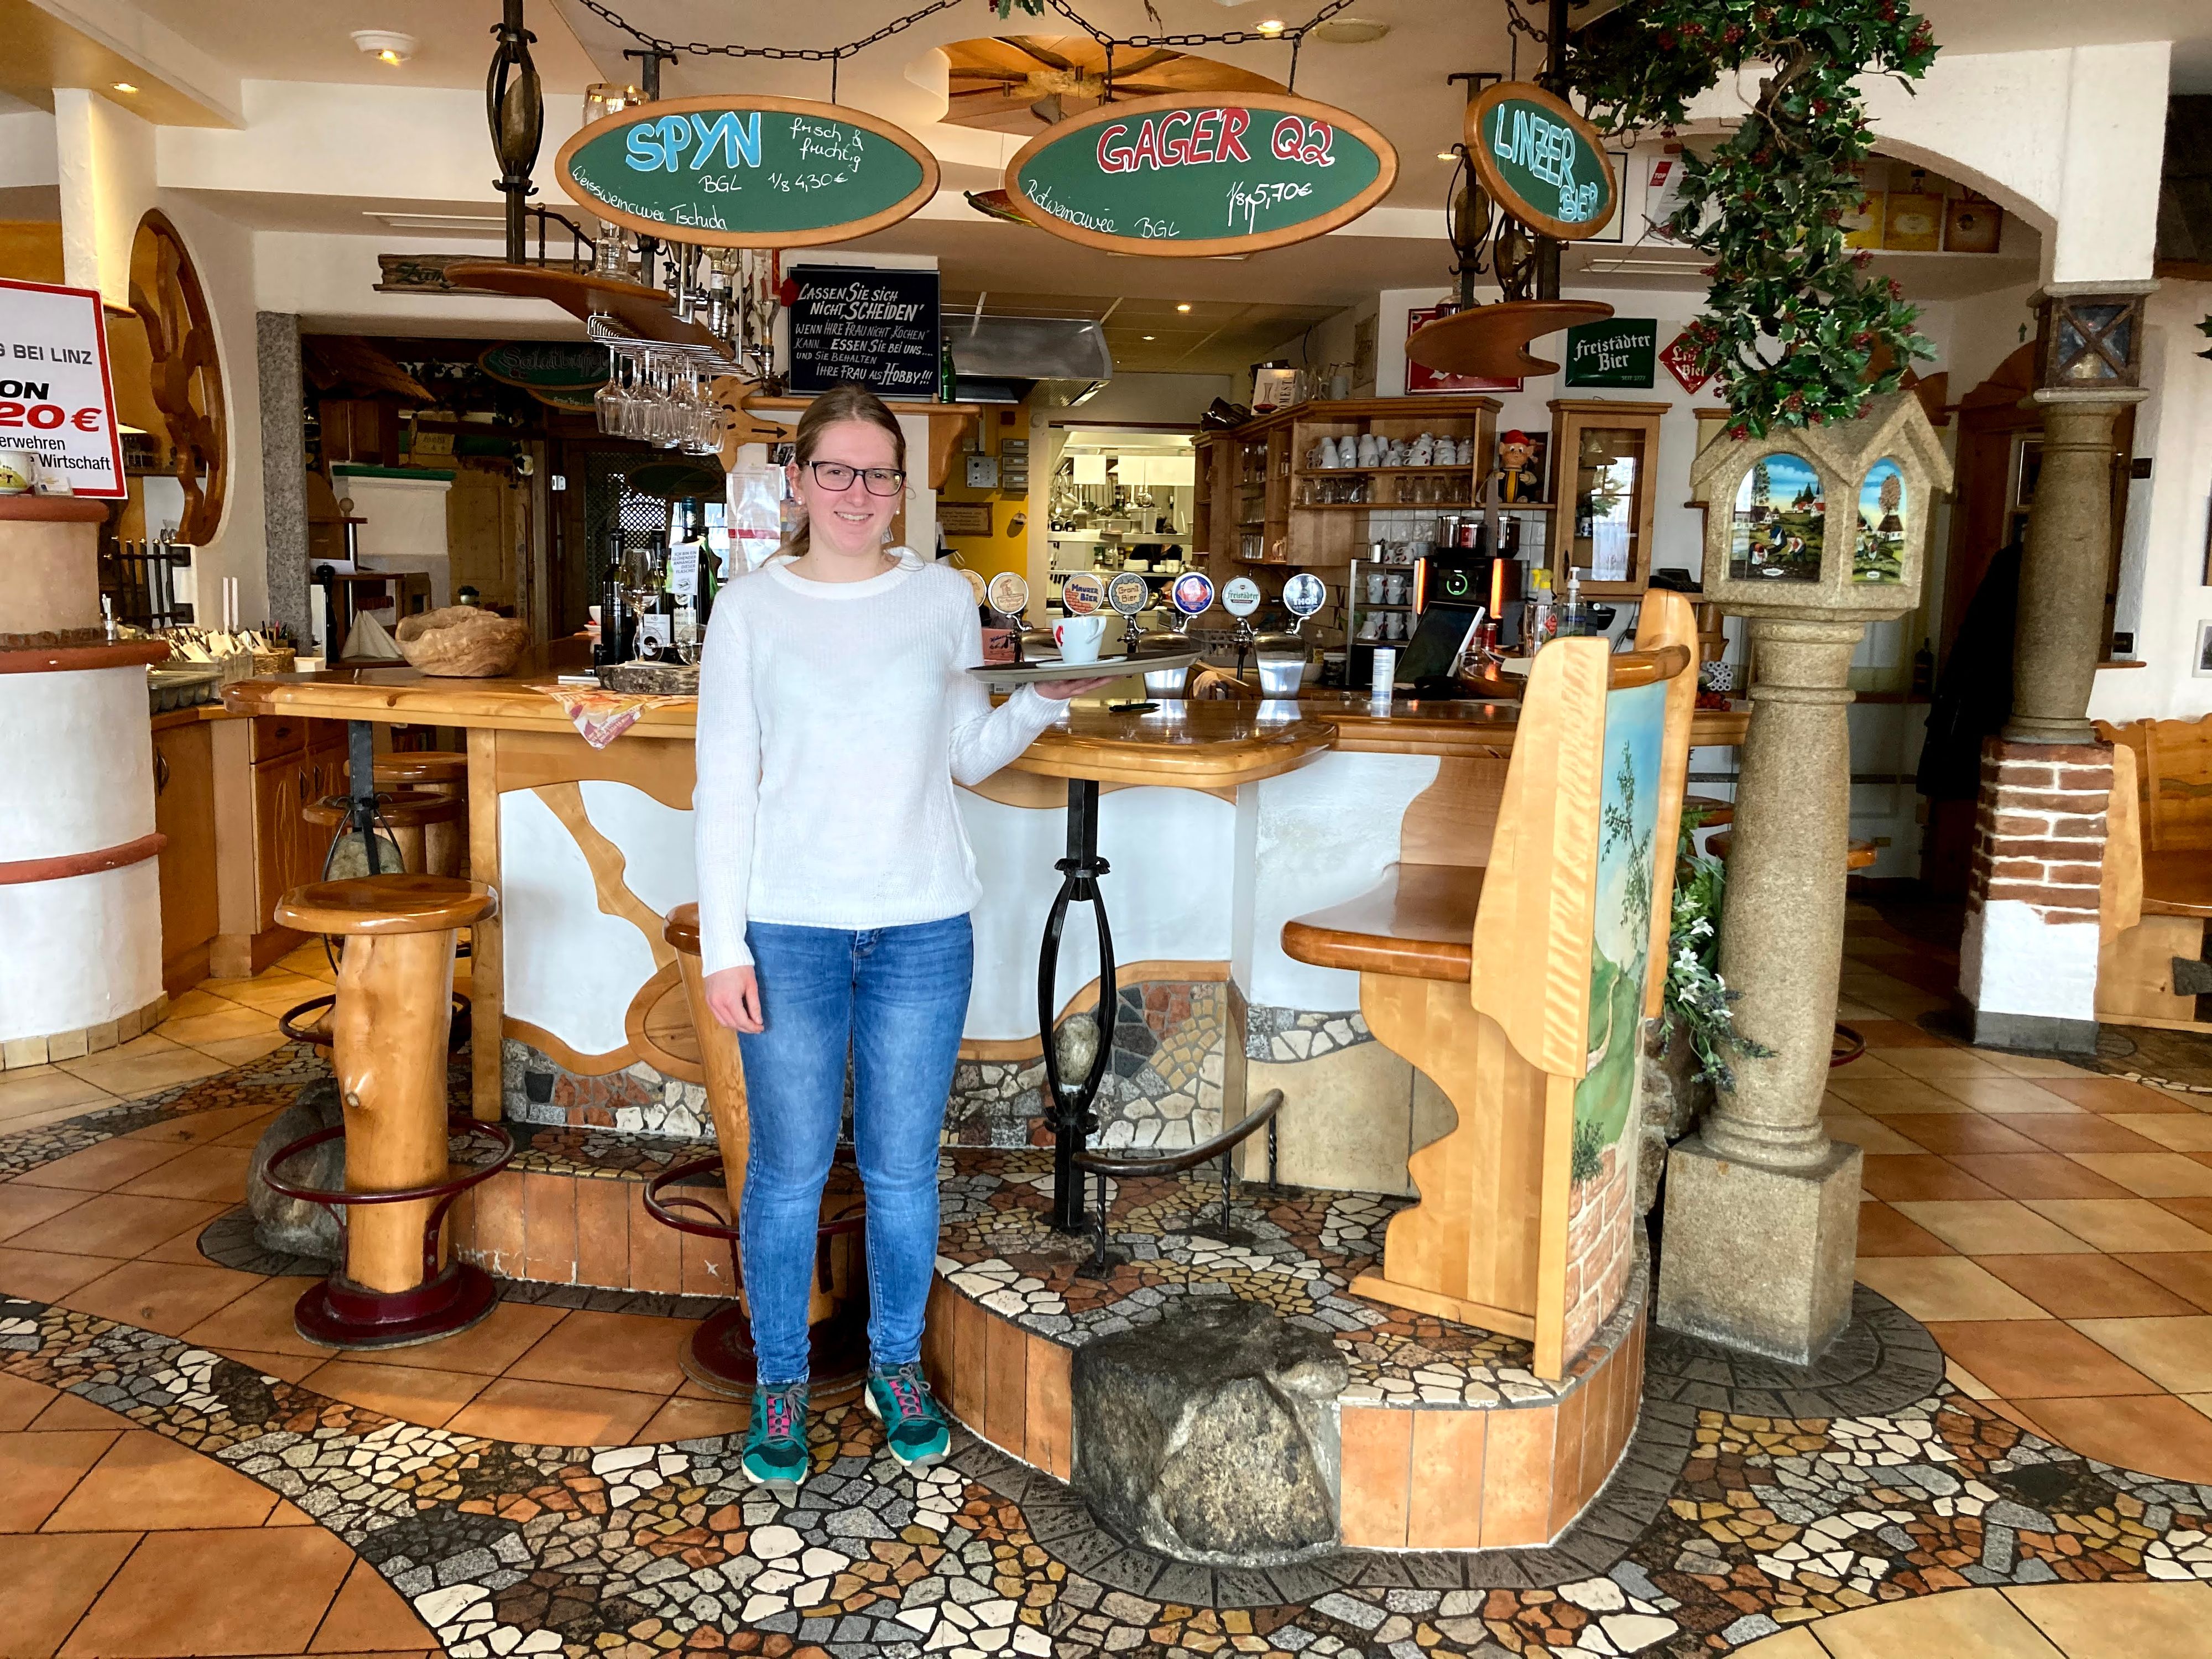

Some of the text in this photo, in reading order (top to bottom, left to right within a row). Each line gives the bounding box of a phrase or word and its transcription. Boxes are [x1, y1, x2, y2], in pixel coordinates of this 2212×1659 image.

[625, 111, 762, 172] SPYN
[790, 117, 863, 151] frisch &
[1097, 108, 1335, 174] GAGER Q2
[1494, 103, 1576, 193] LINZER
[698, 175, 742, 193] BGL
[768, 173, 848, 192] 1/8 4,30€
[1134, 217, 1180, 238] BGL
[797, 283, 847, 300] LASSEN
[795, 324, 821, 335] WENN
[844, 322, 868, 336] FRAU
[831, 338, 868, 351] ESSEN
[13, 344, 44, 361] BEI
[51, 347, 93, 365] LINZ
[831, 352, 878, 365] BEHALTEN
[1597, 353, 1629, 372] Bier
[841, 365, 867, 379] FRAU
[869, 370, 881, 380] ALS
[39, 453, 111, 470] Wirtschaft
